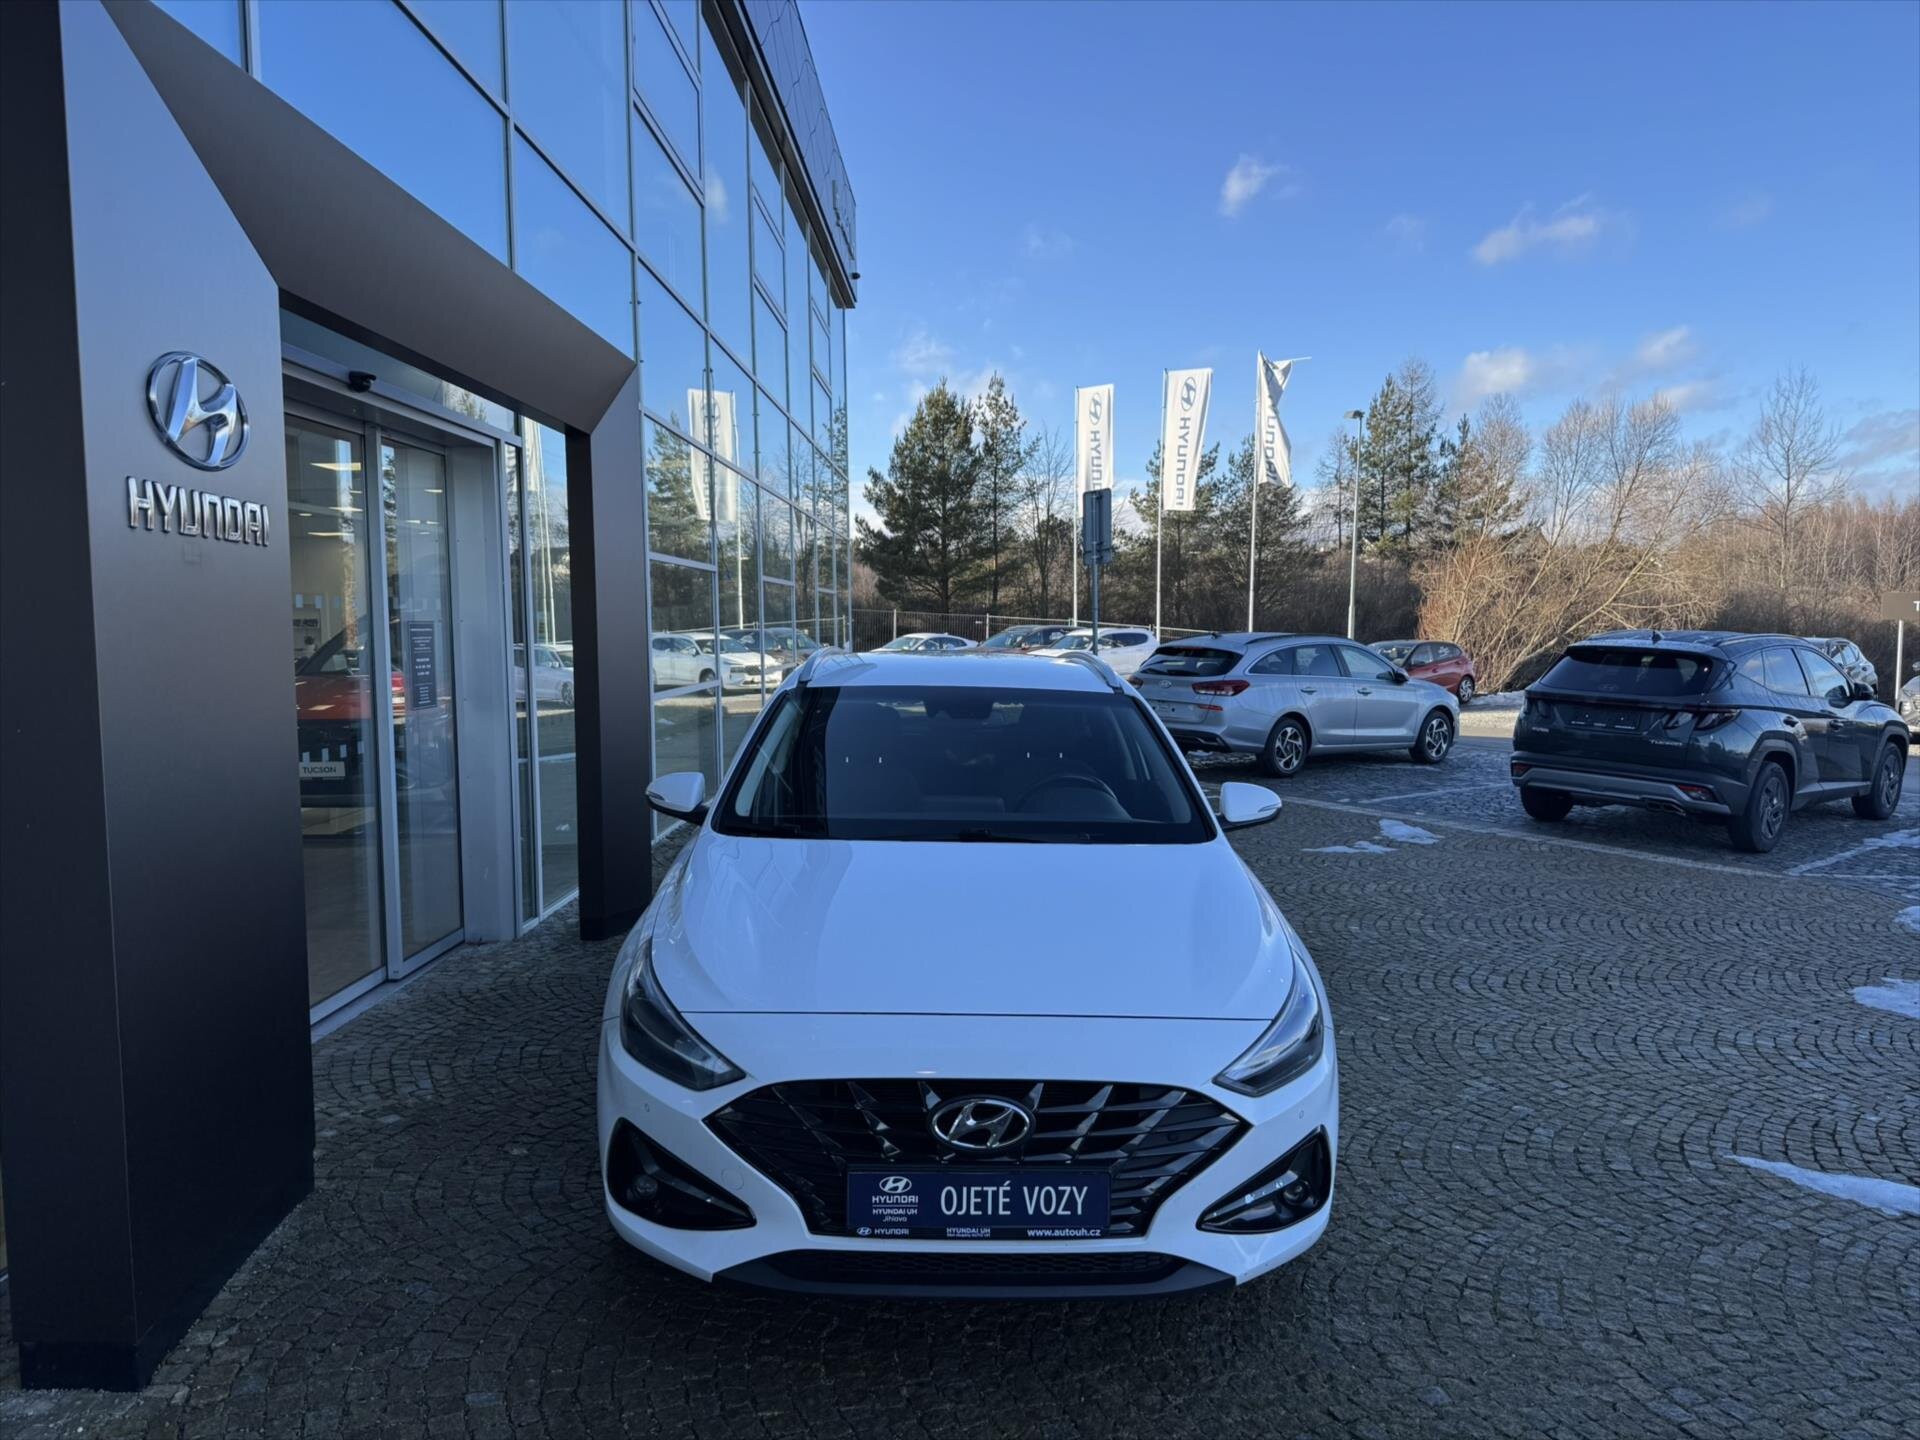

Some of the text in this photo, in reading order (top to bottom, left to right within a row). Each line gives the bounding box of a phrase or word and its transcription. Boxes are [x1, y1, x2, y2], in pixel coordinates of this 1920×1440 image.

[1175, 416, 1191, 506] HYUNDAI
[127, 475, 270, 546] HYUNDAI
[872, 1195, 919, 1204] HYUNDAI
[940, 1180, 1089, 1216] OJETÉ VOZY
[1027, 1227, 1101, 1237] www.autouh.cz
